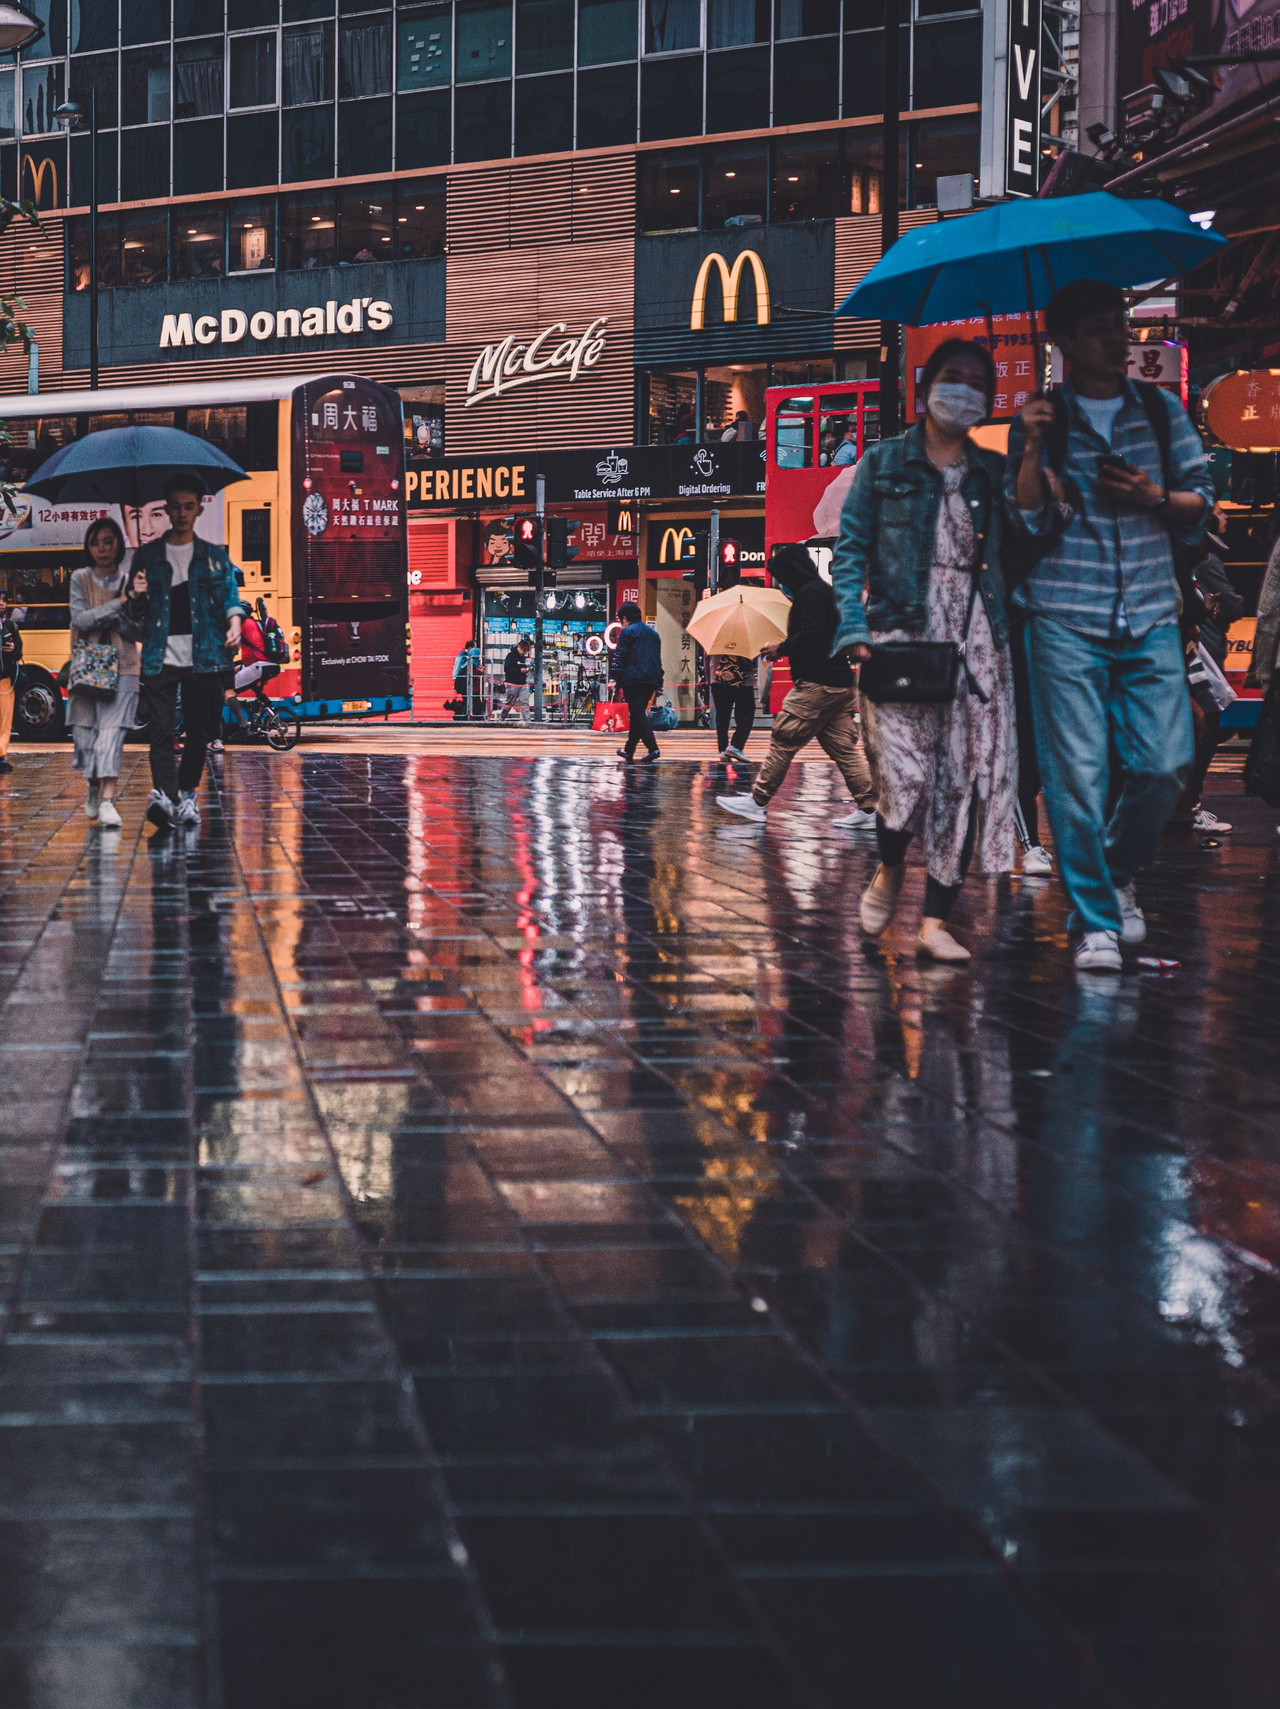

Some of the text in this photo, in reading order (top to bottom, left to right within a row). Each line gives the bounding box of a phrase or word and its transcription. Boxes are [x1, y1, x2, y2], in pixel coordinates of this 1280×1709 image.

[159, 297, 393, 348] McDonald's
[467, 317, 609, 397] McCafé
[323, 402, 377, 431] 周大福
[405, 465, 525, 501] PERIENCE
[574, 487, 650, 499] Table Service After 6 PM
[678, 483, 731, 497] Digital Ordering
[332, 499, 359, 511] 周大福
[373, 500, 399, 511] MARK
